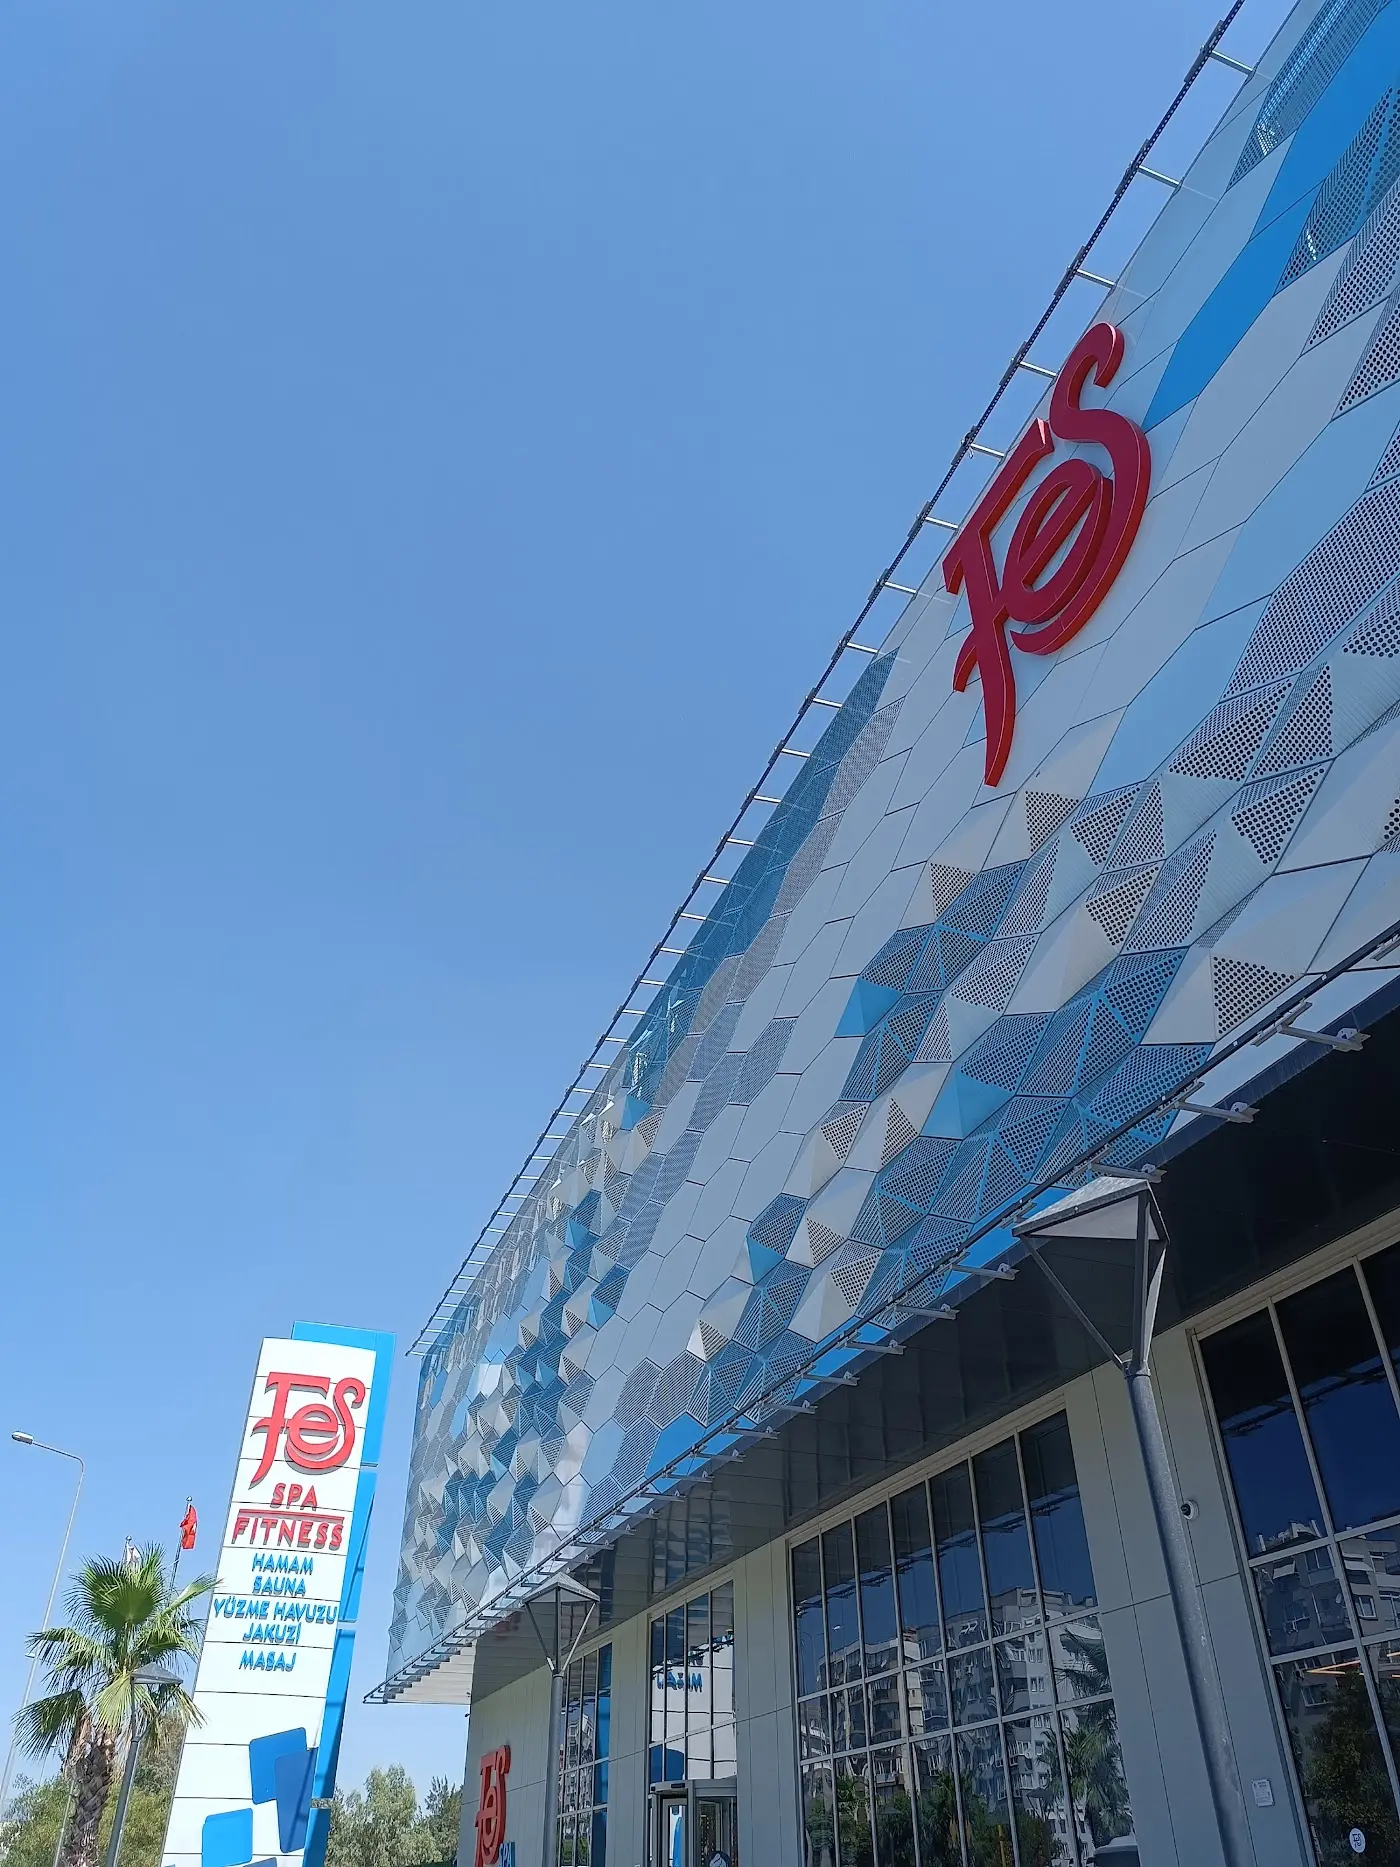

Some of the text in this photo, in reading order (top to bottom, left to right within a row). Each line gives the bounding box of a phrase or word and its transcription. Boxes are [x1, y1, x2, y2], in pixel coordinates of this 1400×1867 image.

[270, 1482, 318, 1512] SPA
[231, 1516, 344, 1551] FITNESS
[251, 1552, 313, 1576] HAMAM
[252, 1575, 306, 1597] SAUNA
[213, 1596, 338, 1625] YÜZME HAVUZU
[239, 1650, 297, 1673] MASAJ
